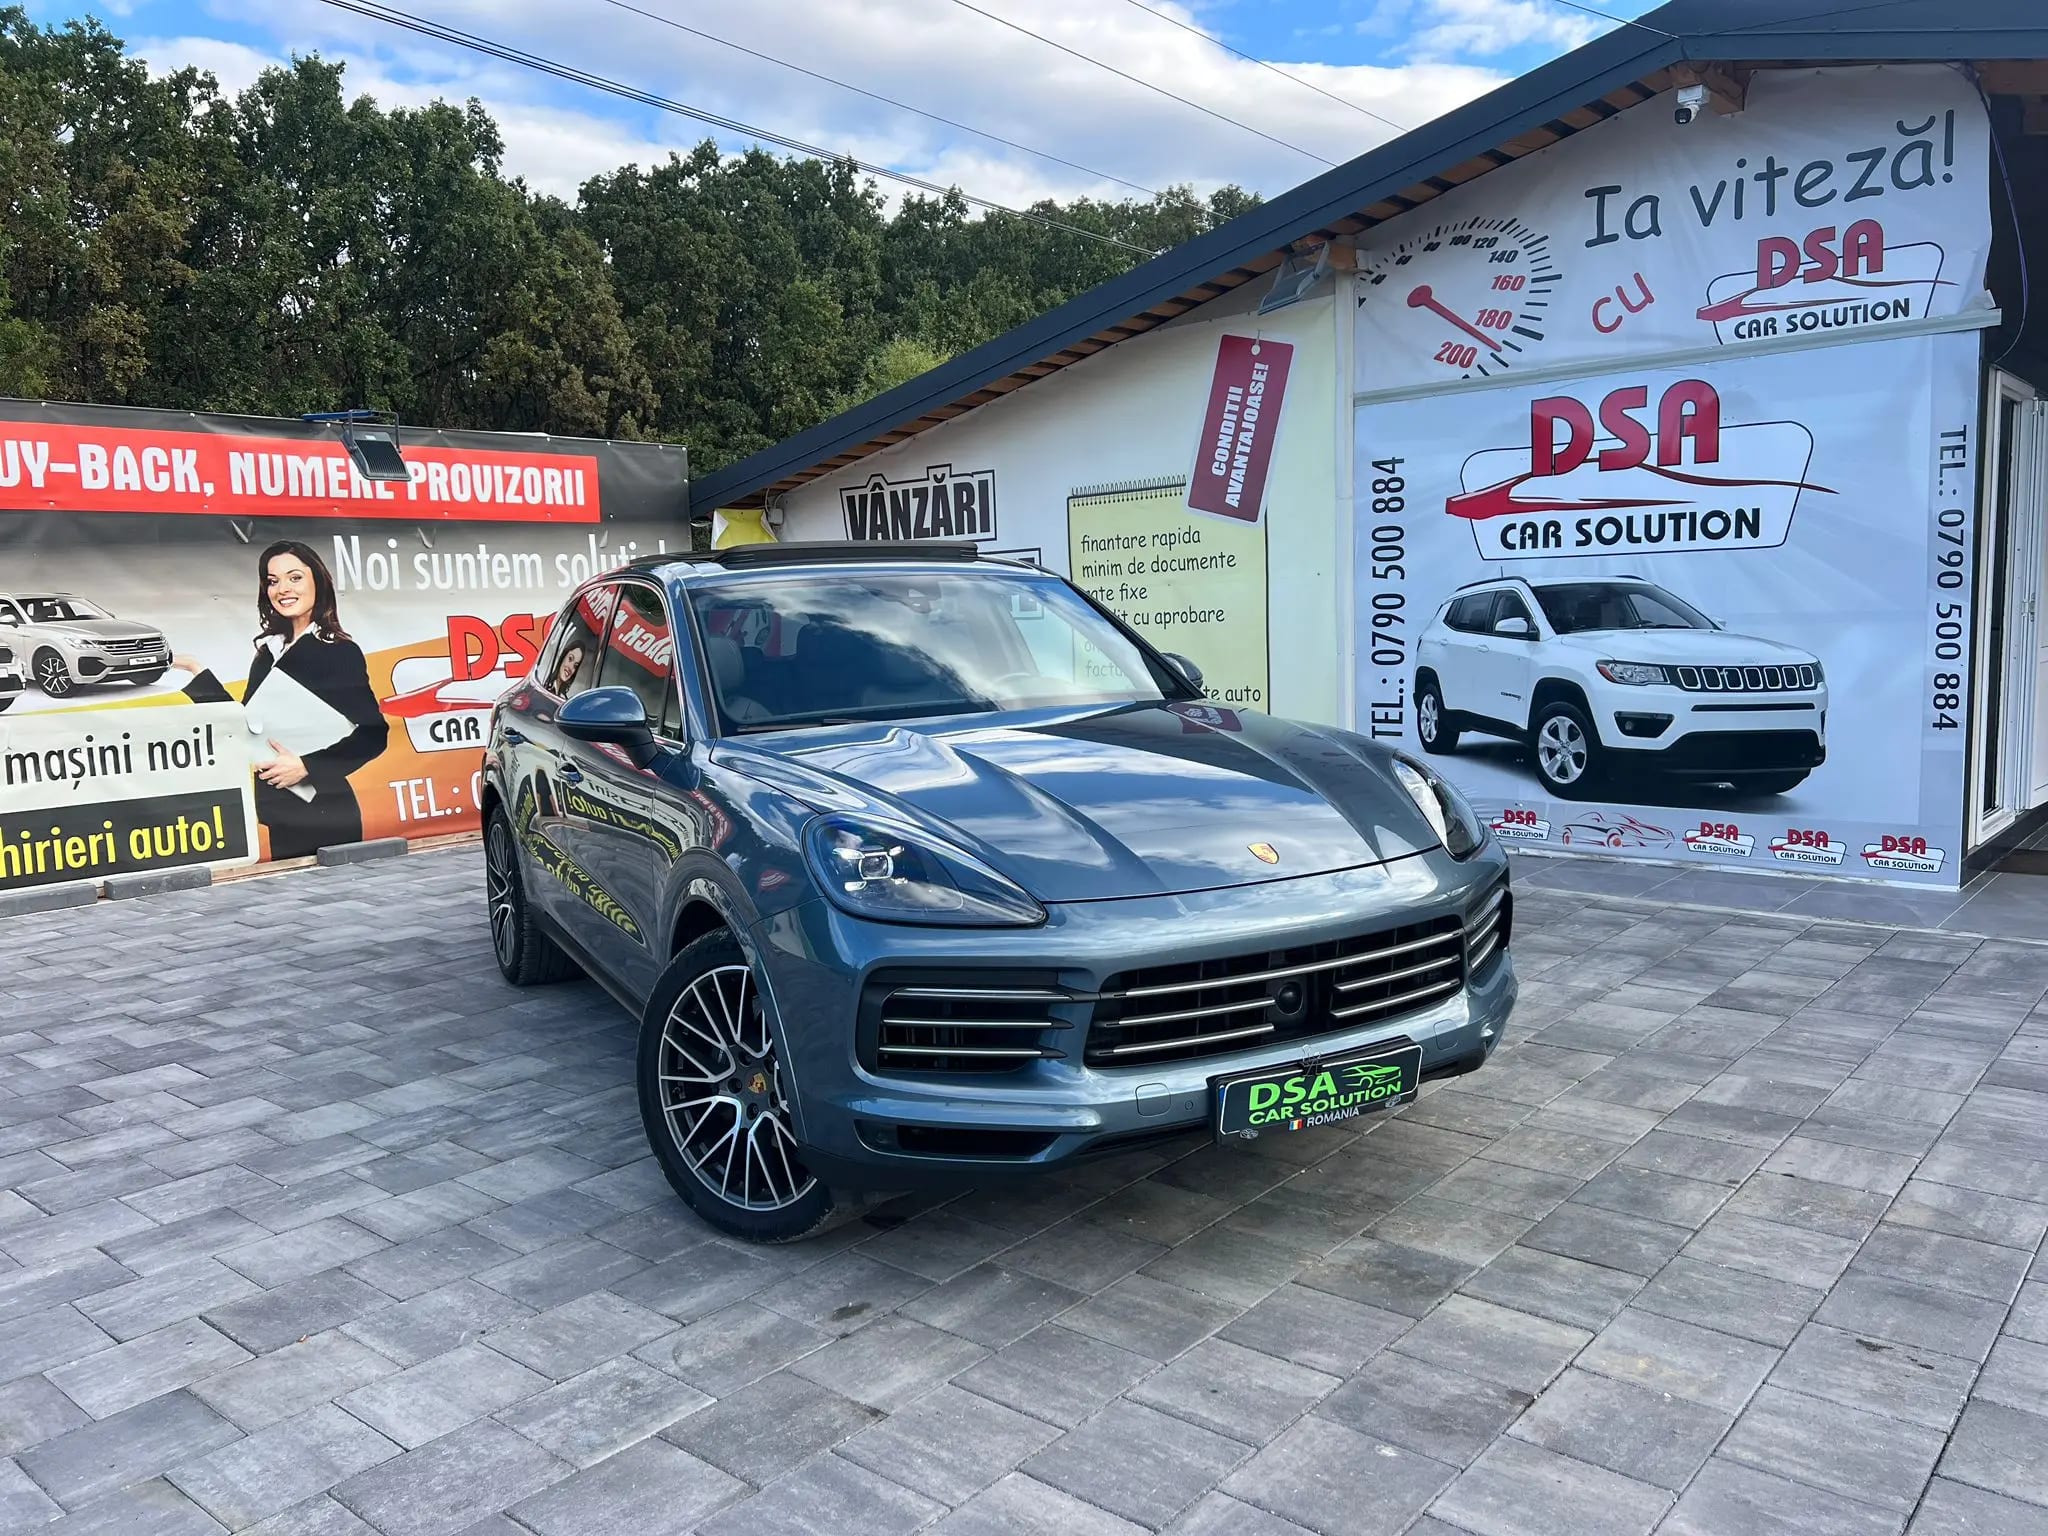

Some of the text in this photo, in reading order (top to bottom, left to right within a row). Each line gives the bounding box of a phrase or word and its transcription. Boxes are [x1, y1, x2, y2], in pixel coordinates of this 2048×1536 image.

[1585, 109, 1955, 248] Ia viteză!
[1449, 234, 1473, 246] 100
[1472, 236, 1499, 249] 120
[1488, 250, 1519, 263] 140
[1757, 218, 1884, 290] DSA
[1491, 274, 1526, 292] 160
[1475, 308, 1513, 330] 180
[1592, 272, 1655, 334] cu
[1734, 298, 1910, 340] CAR SOLUTION
[1434, 341, 1478, 369] 200
[1211, 386, 1244, 477] CONDITII
[1225, 362, 1270, 509] AVANTAJOASE!
[1530, 378, 1721, 478] DSA
[406, 460, 585, 506] PROVIZORII
[1371, 456, 1405, 513] 884
[845, 472, 992, 541] VÂNZĂRI
[1081, 525, 1201, 554] finantare rapida
[1500, 507, 1761, 551] CAR SOLUTION
[333, 534, 400, 591] Noi
[413, 543, 543, 590] suntem
[1082, 551, 1237, 578] minim de documente
[1371, 525, 1406, 580] 500
[1936, 509, 1966, 589] 0790
[1119, 582, 1148, 601] fixe
[1133, 612, 1150, 626] cu
[1154, 605, 1226, 630] aprobare
[1371, 593, 1406, 666] 0790
[1935, 602, 1963, 660] 500
[1225, 685, 1261, 702] auto
[1932, 672, 1961, 731] 884
[429, 716, 481, 743] CAR
[4, 723, 216, 790] mașini noi!
[129, 805, 226, 861] auto!
[1503, 809, 1537, 826] DSA
[1512, 830, 1544, 838] SOLUTION
[1700, 822, 1739, 841] DSA
[1693, 843, 1746, 855] CAR SOLUTION
[1787, 828, 1829, 848] DSA
[1881, 834, 1927, 855] DSA
[1797, 853, 1837, 863] SOLUTION
[1873, 859, 1935, 871] CAR SOLUTION
[1249, 1071, 1338, 1112] DSA
[1249, 1081, 1402, 1125] CAR SOLUTION
[1306, 1106, 1360, 1128] ROMANIA
